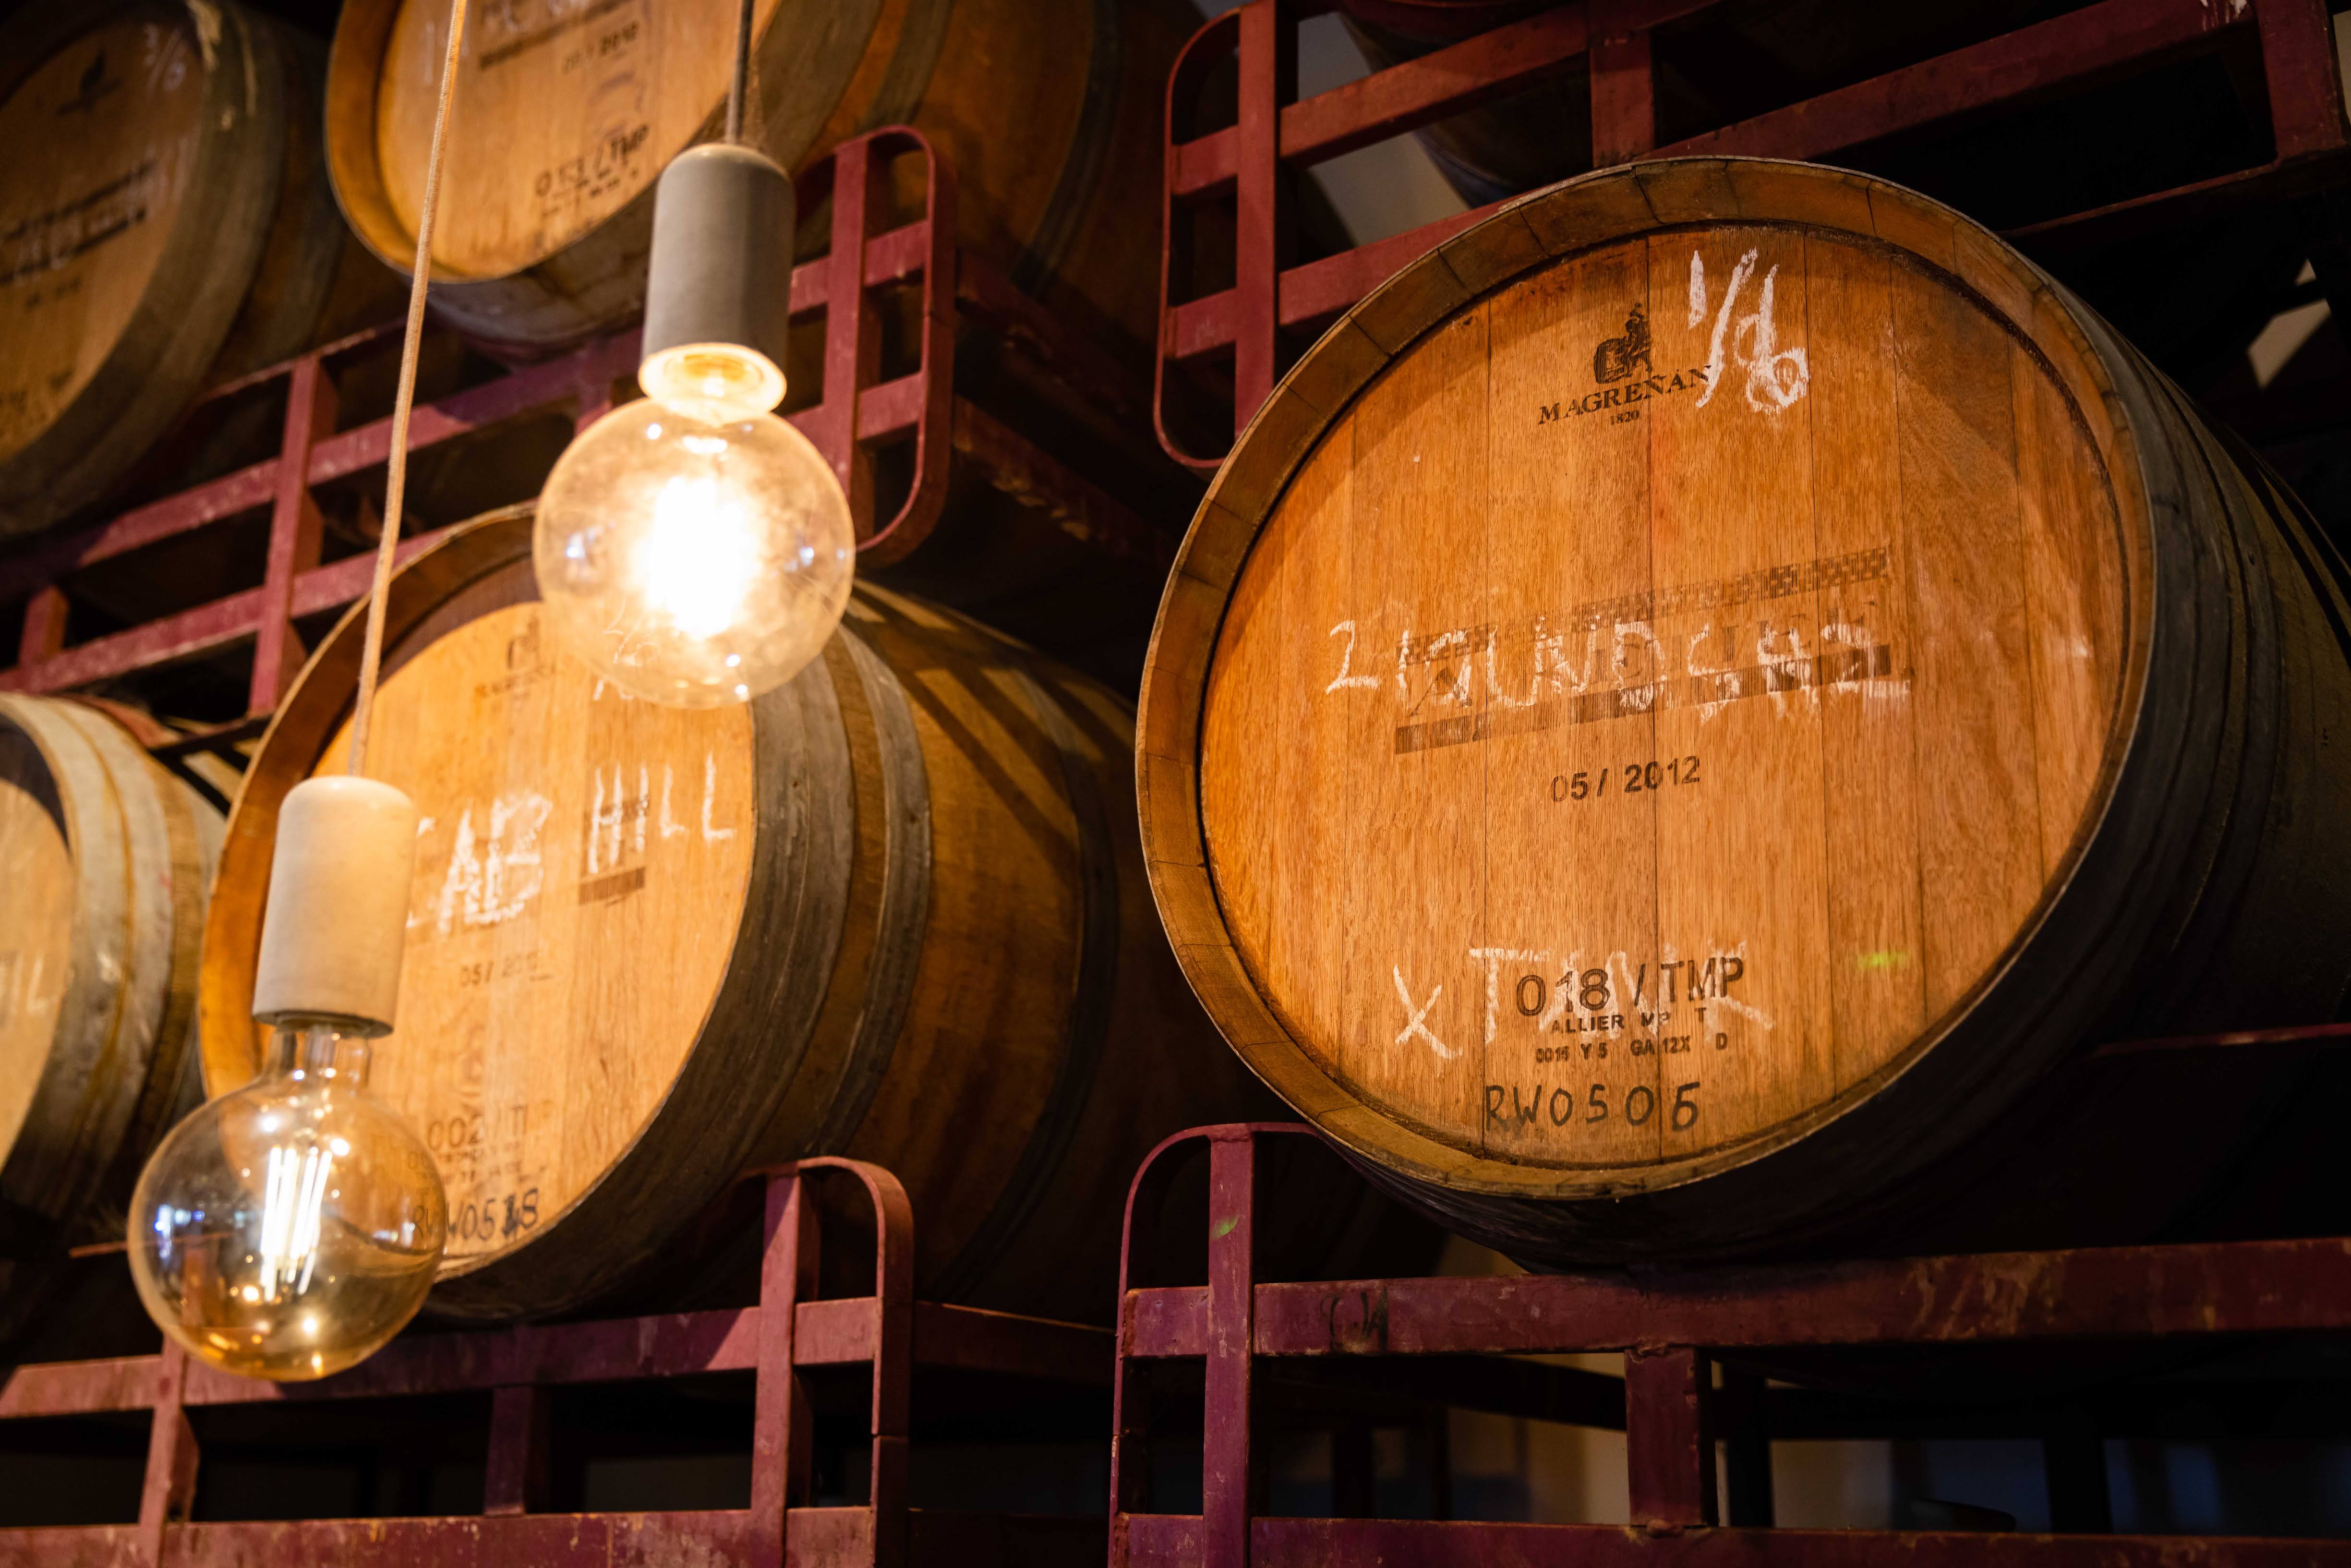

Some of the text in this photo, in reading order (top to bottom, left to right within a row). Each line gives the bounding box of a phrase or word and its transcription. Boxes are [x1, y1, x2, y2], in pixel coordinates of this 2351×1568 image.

[1610, 409, 1640, 426] 1820
[1624, 755, 1700, 794] 2012
[587, 749, 738, 875] HILL
[1660, 956, 1745, 1002] TMP
[1550, 1013, 1625, 1035] ALLIER
